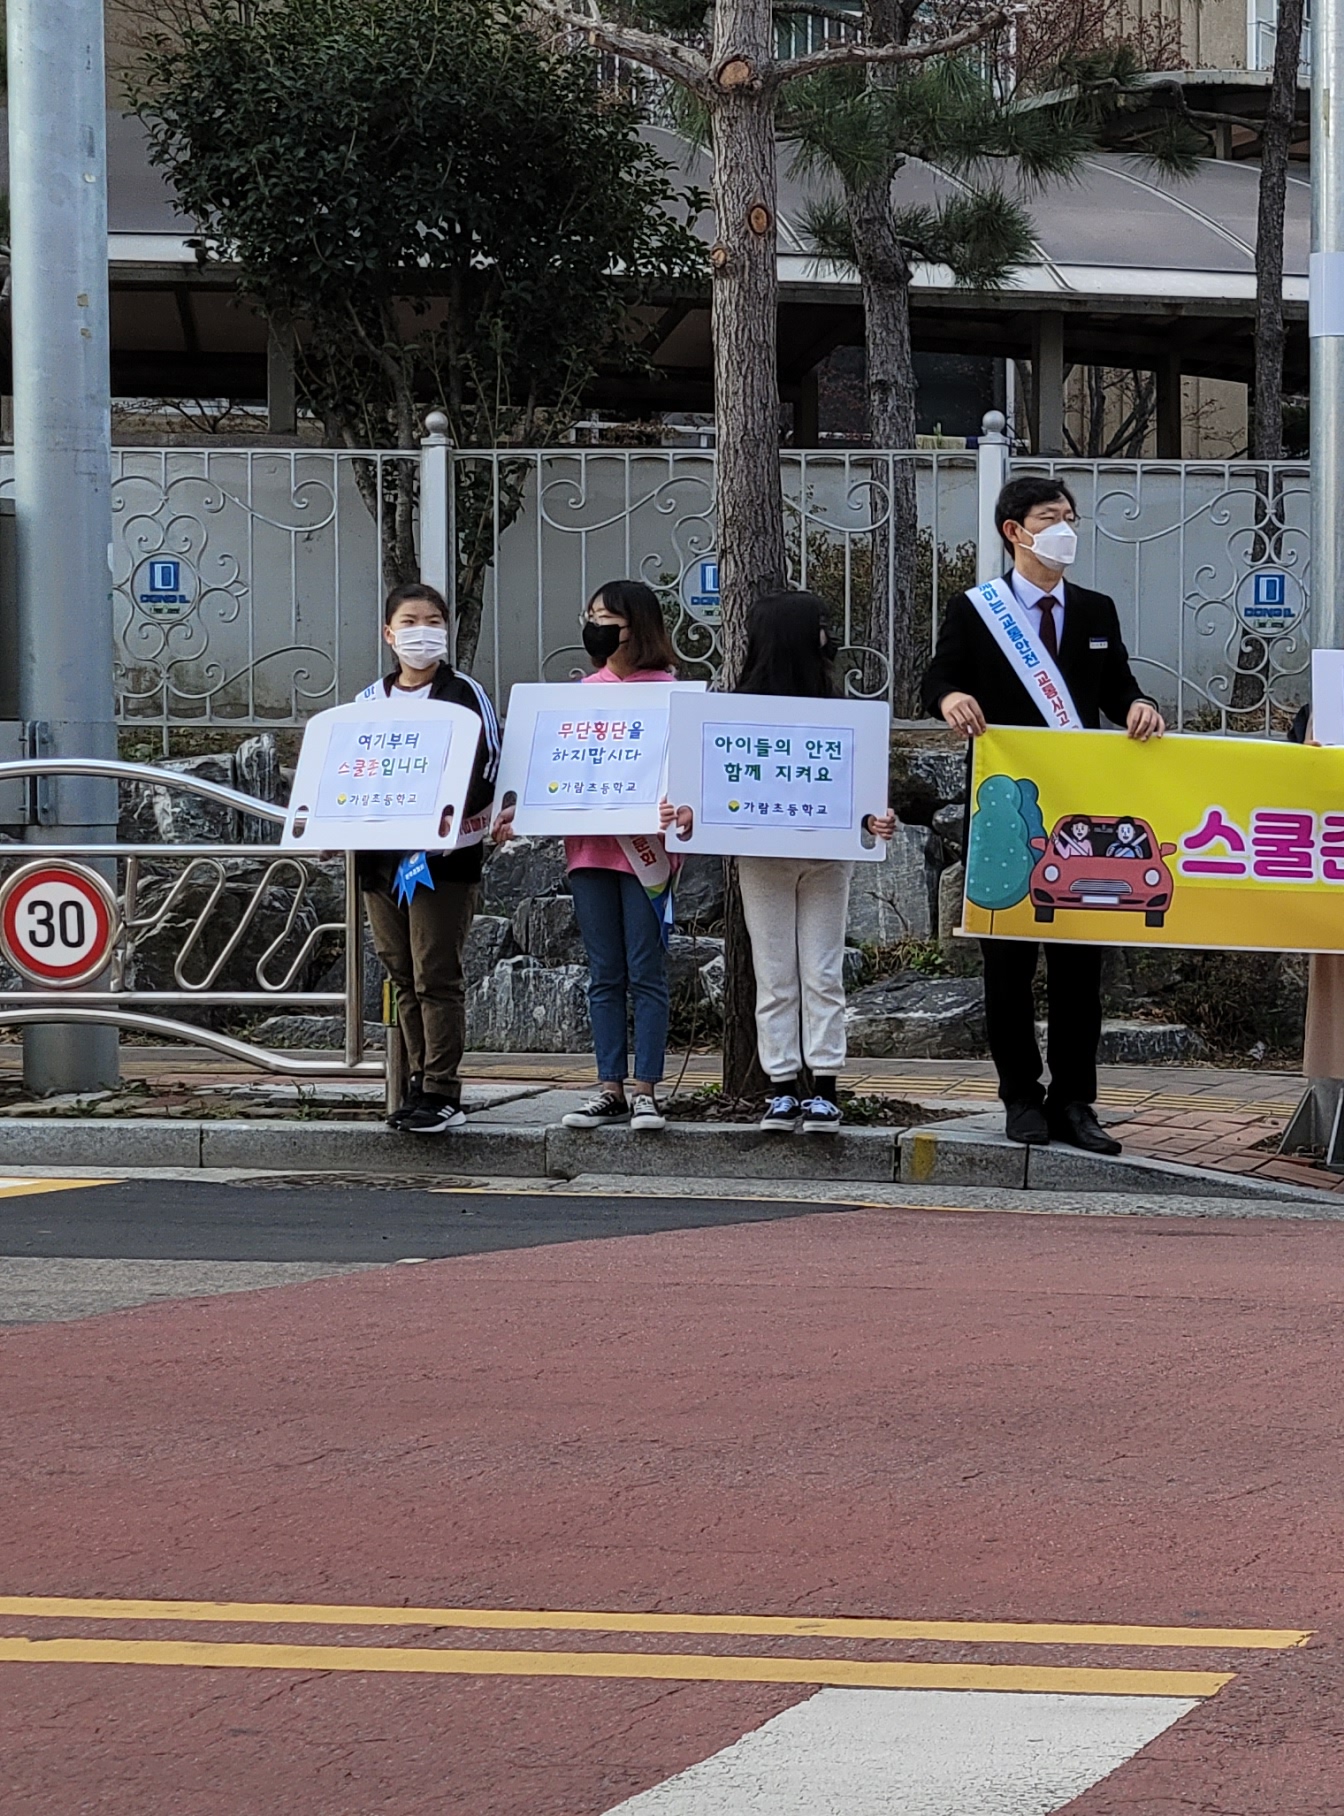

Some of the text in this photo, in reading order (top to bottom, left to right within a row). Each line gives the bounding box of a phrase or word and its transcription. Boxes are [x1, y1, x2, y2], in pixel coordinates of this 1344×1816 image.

[998, 613, 1040, 668] 교통안전
[1033, 669, 1071, 727] 교통사고
[557, 721, 645, 740] 무단횡단을
[357, 732, 420, 750] 여기부터
[714, 736, 842, 760] 아이들의 안전
[551, 747, 642, 765] 하지맙시다
[337, 756, 429, 778] 스쿨존입니다
[724, 762, 833, 783] 함께 지켜요
[560, 781, 637, 795] 가람초등학교
[349, 793, 417, 806] 가람초등학교
[743, 801, 828, 816] 가람초등학교
[27, 899, 86, 948] 30
